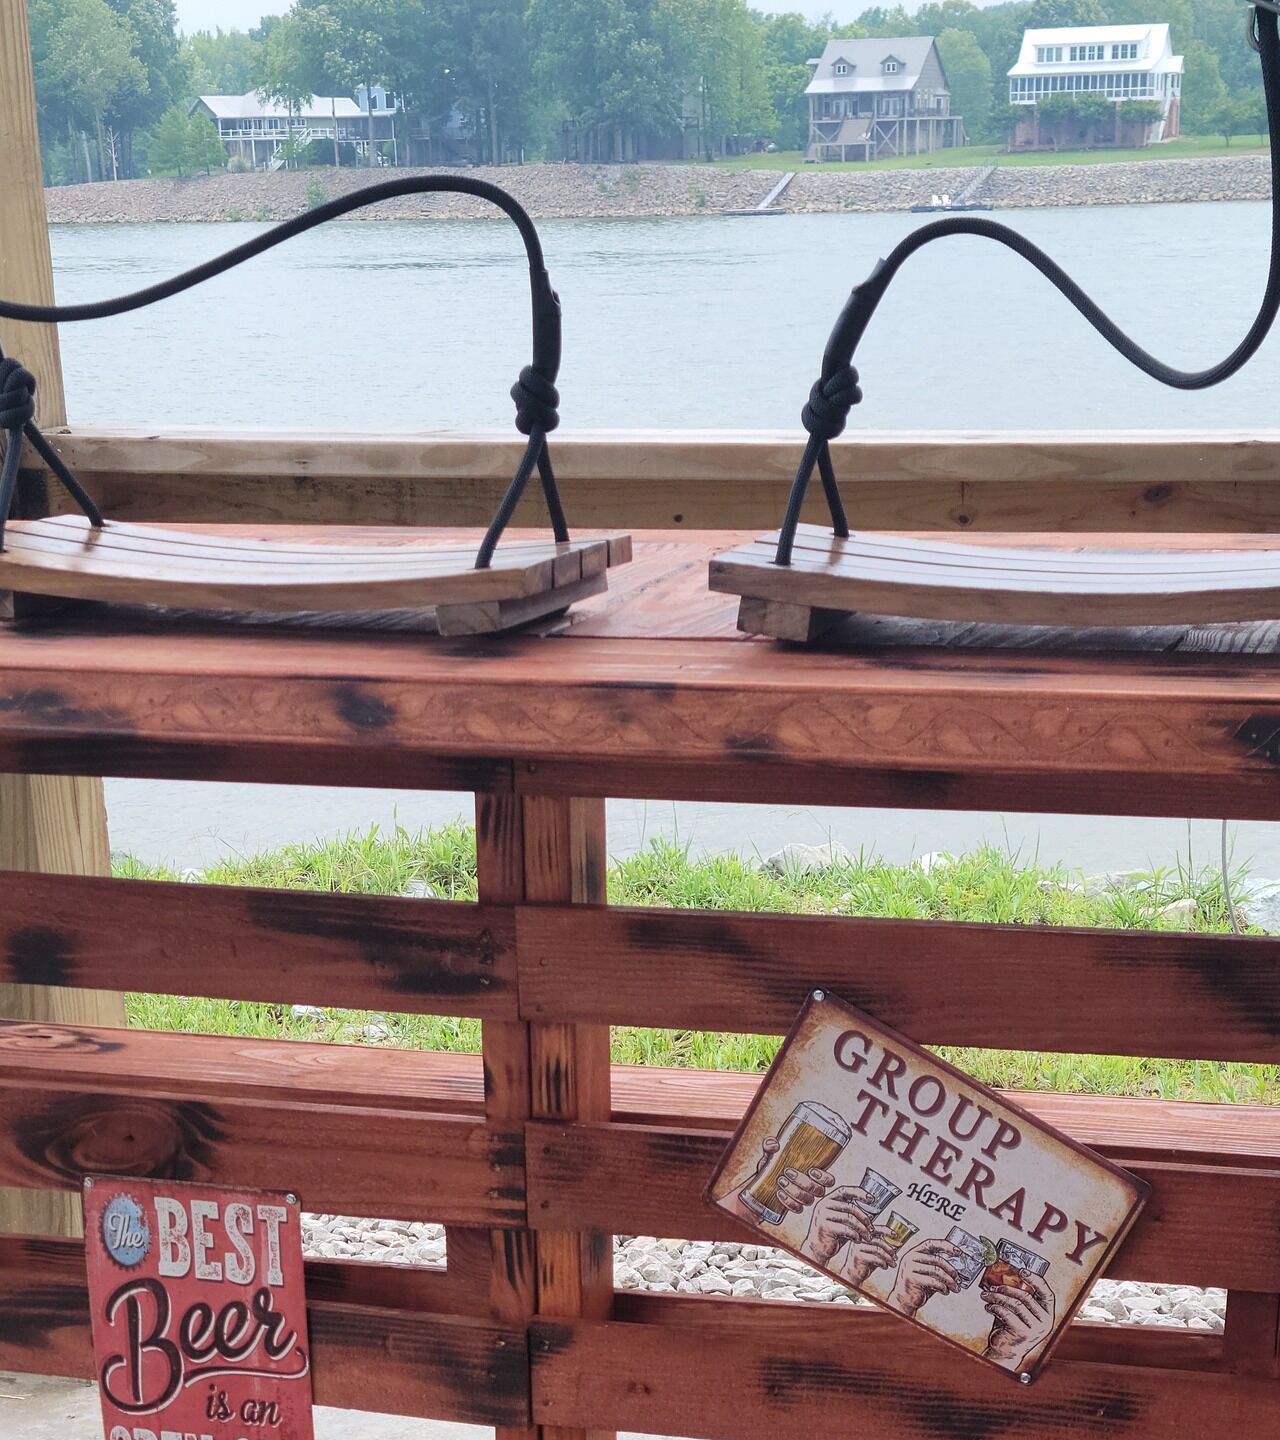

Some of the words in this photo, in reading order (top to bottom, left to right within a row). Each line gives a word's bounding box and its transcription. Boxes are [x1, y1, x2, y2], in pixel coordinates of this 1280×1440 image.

[833, 1030, 1021, 1160] GROUP
[850, 1089, 1109, 1265] THERAPY
[907, 1182, 967, 1222] HERE
[108, 1213, 144, 1249] The
[154, 1196, 287, 1286] BEST
[101, 1278, 298, 1415] Beer
[205, 1383, 236, 1424] is
[241, 1399, 282, 1428] an
